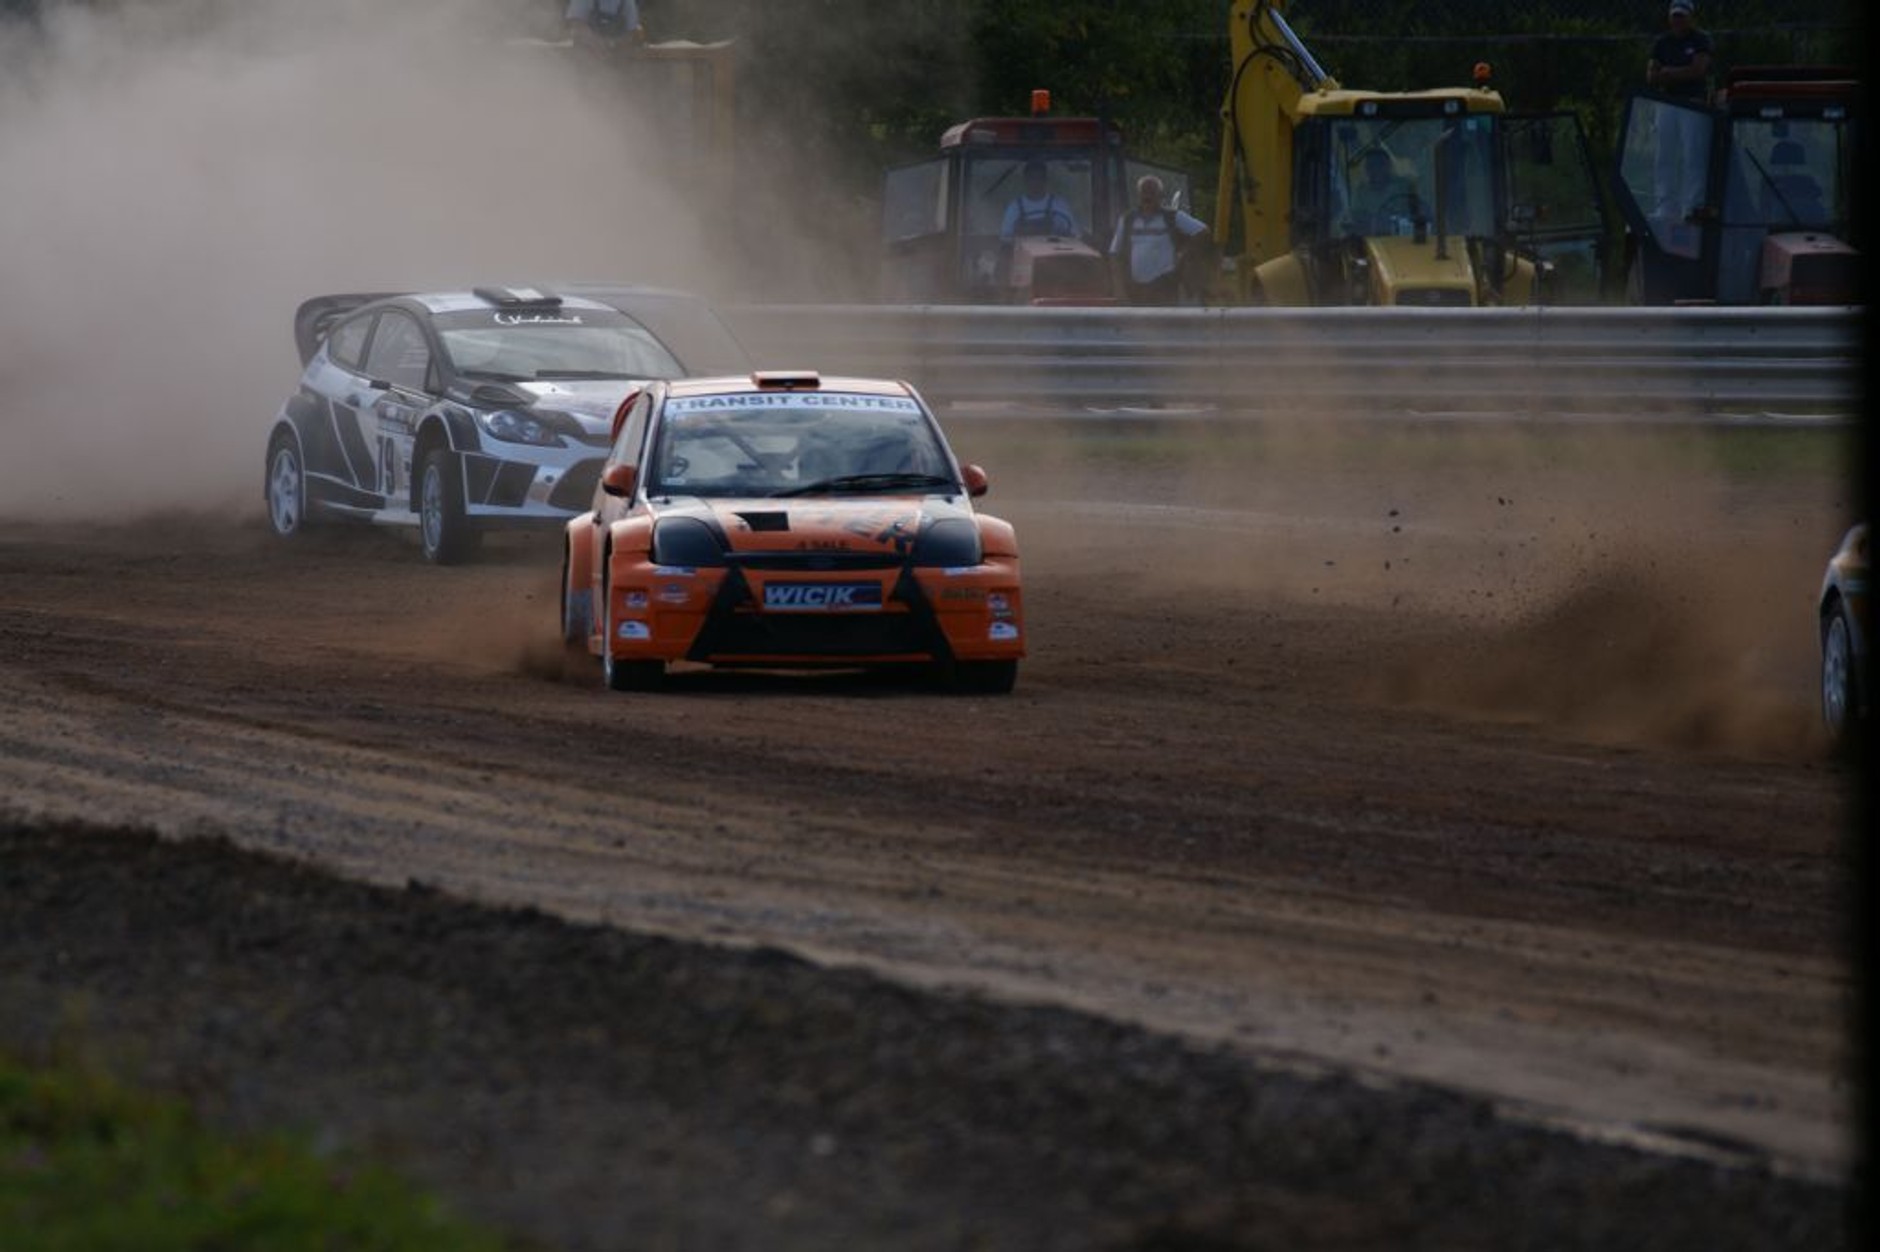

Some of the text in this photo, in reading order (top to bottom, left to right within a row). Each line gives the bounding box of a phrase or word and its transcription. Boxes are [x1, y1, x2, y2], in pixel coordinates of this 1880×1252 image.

[671, 394, 917, 411] TRANSIT CENTER
[765, 586, 856, 605] WICIK
